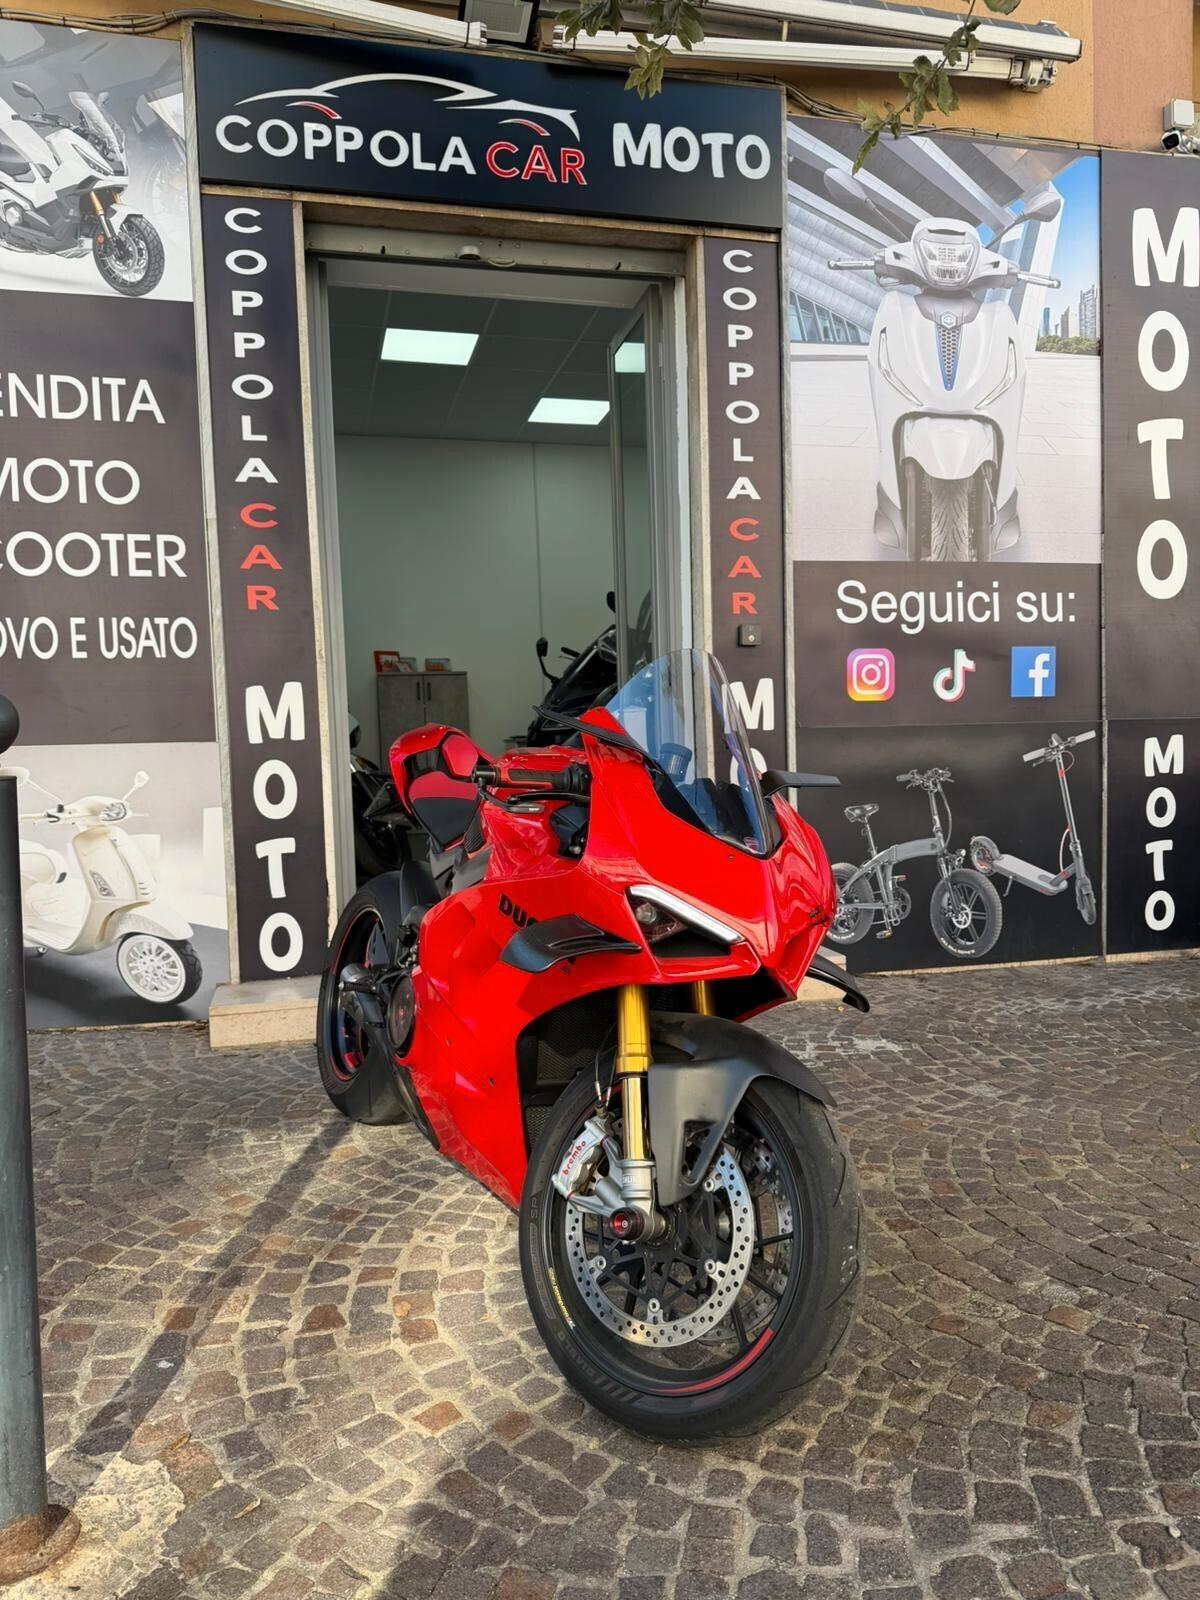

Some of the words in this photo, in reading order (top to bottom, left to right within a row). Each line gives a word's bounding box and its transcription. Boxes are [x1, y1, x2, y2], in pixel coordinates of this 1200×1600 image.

[216, 114, 477, 175] COPPOLA
[486, 140, 588, 186] CAR
[612, 122, 771, 180] MOTO
[224, 207, 279, 484] COPPOLA
[722, 249, 762, 500] COPPOLA
[0, 372, 166, 424] NDITA
[1131, 206, 1200, 600] MOTO
[0, 530, 187, 578] OOTER
[239, 503, 283, 612] CAR
[727, 517, 763, 615] CAR
[0, 616, 59, 660] VO
[69, 616, 88, 659] E
[98, 616, 198, 660] USATO
[836, 579, 1000, 635] Seguici
[1016, 591, 1077, 623] su:
[245, 681, 306, 972] MOTO
[1144, 734, 1184, 931] MOTO
[562, 1140, 586, 1176] brembo
